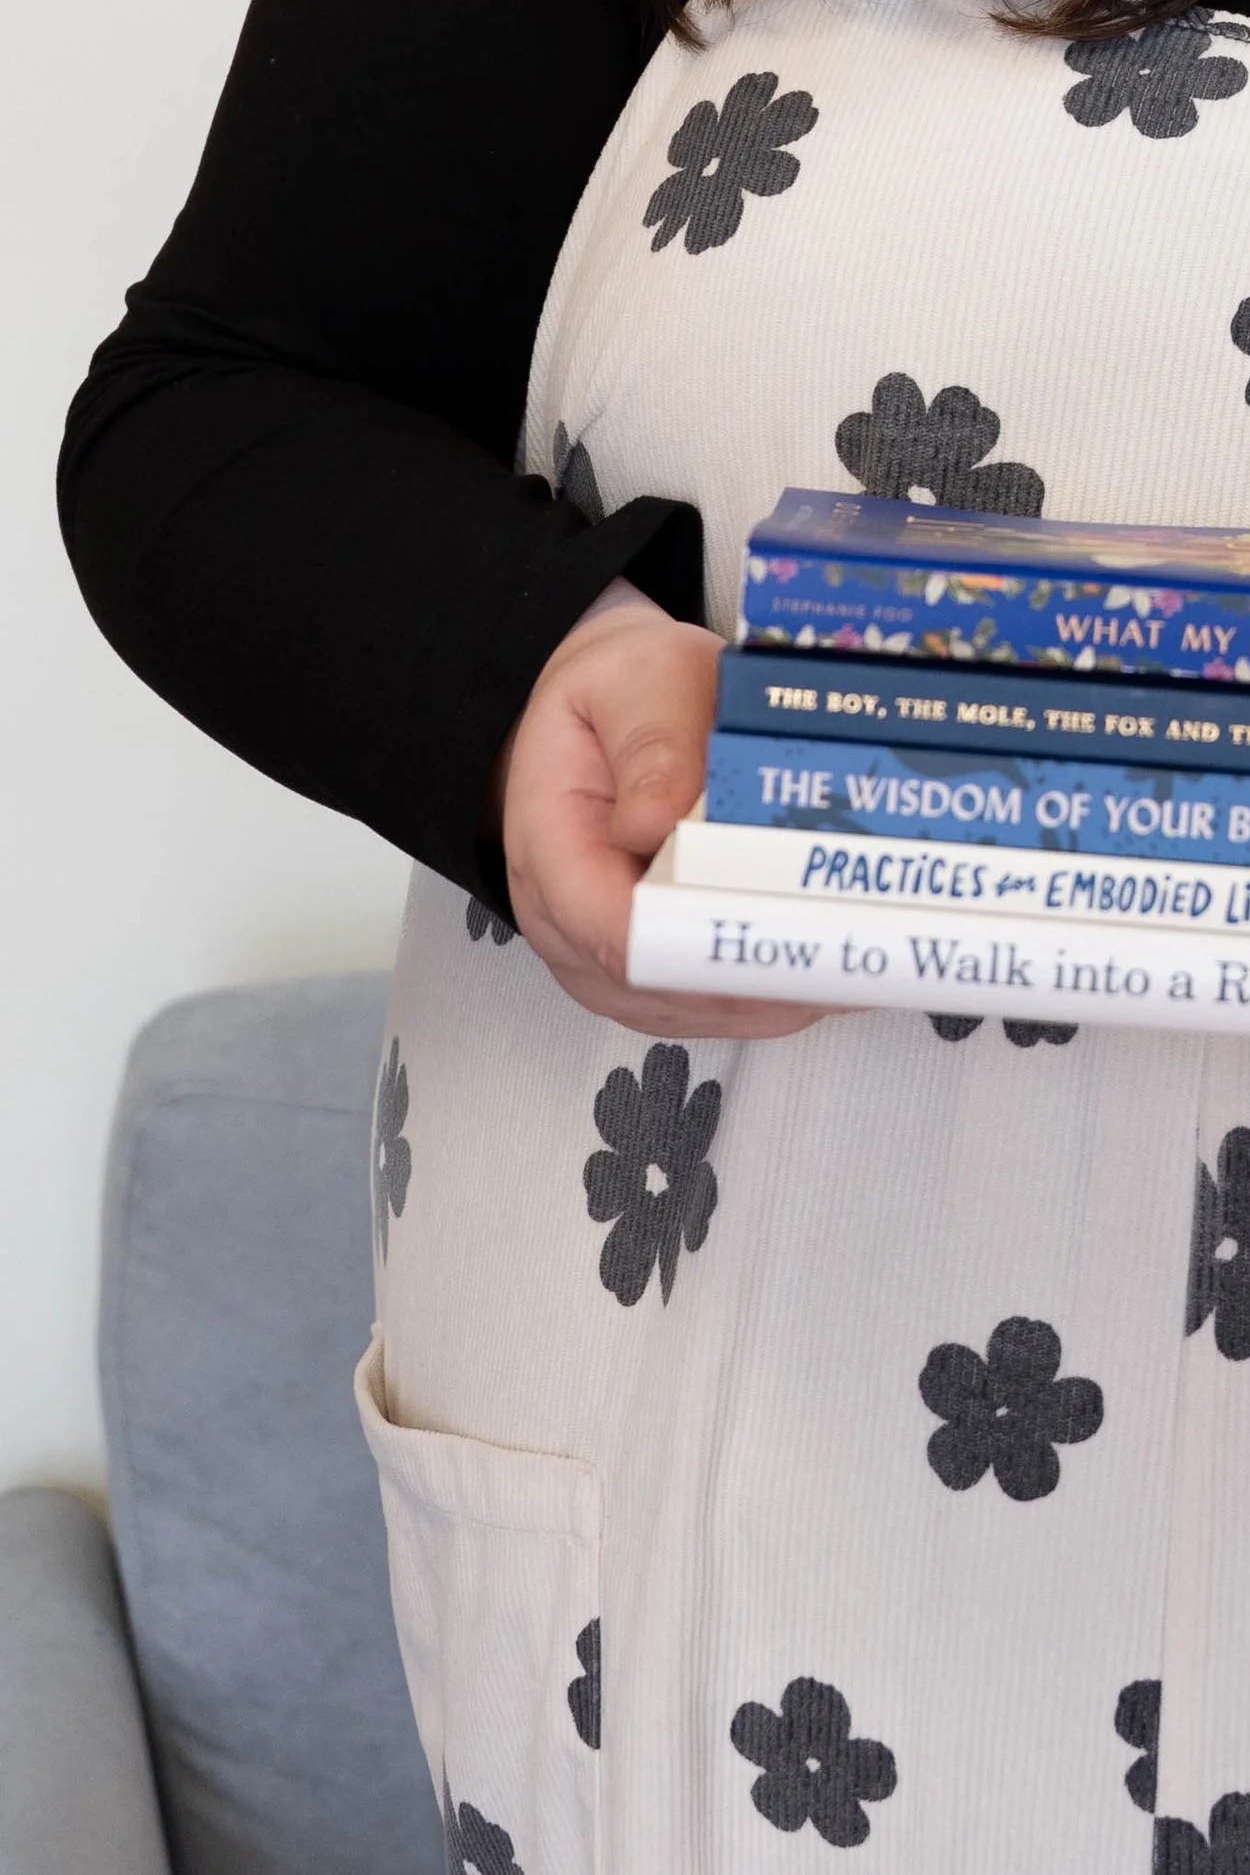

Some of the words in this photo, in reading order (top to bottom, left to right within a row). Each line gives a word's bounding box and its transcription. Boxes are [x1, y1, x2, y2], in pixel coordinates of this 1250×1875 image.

[1055, 612, 1165, 650] WHAT
[1180, 624, 1236, 655] MY
[765, 686, 818, 711] THE
[826, 692, 887, 719] BOY,
[895, 697, 947, 721] THE
[957, 702, 1036, 731] MOLE,
[1043, 709, 1097, 734] THE
[1104, 714, 1155, 738] FOX
[1165, 719, 1221, 743] AND
[758, 766, 834, 810] THE
[845, 774, 1022, 825] WISDOM
[1035, 790, 1092, 830] OF
[1103, 795, 1215, 840] YOUR
[994, 872, 1036, 898] for
[708, 919, 821, 969] How
[841, 933, 890, 977] to
[908, 935, 1034, 987] Walk
[1053, 948, 1151, 996] into
[1167, 970, 1195, 1001] a
